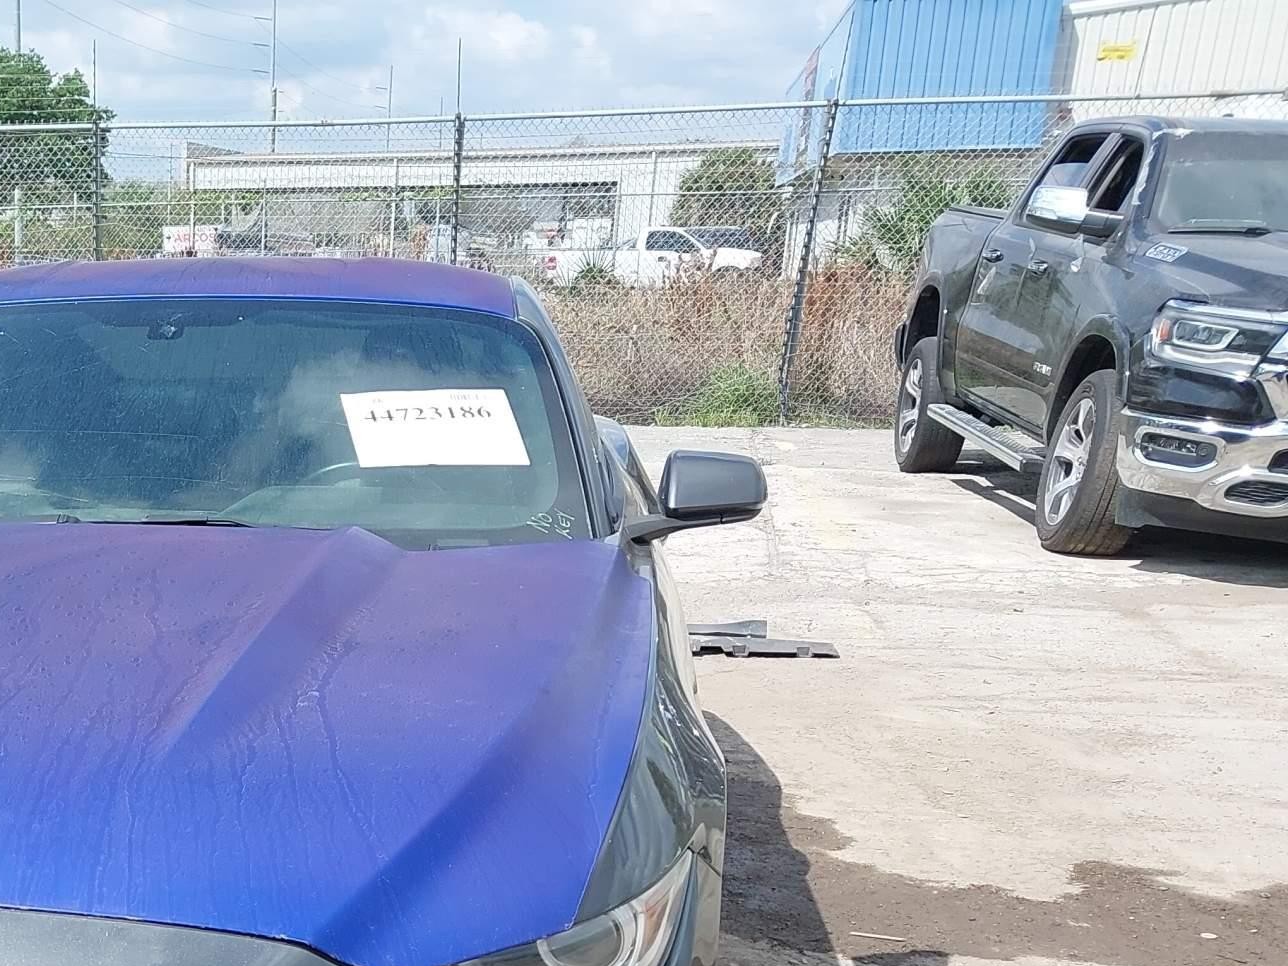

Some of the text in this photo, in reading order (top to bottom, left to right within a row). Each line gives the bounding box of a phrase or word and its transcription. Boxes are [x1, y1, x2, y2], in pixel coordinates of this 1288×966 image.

[363, 406, 492, 423] 44723186
[526, 512, 553, 534] NO
[554, 508, 576, 540] KEY
